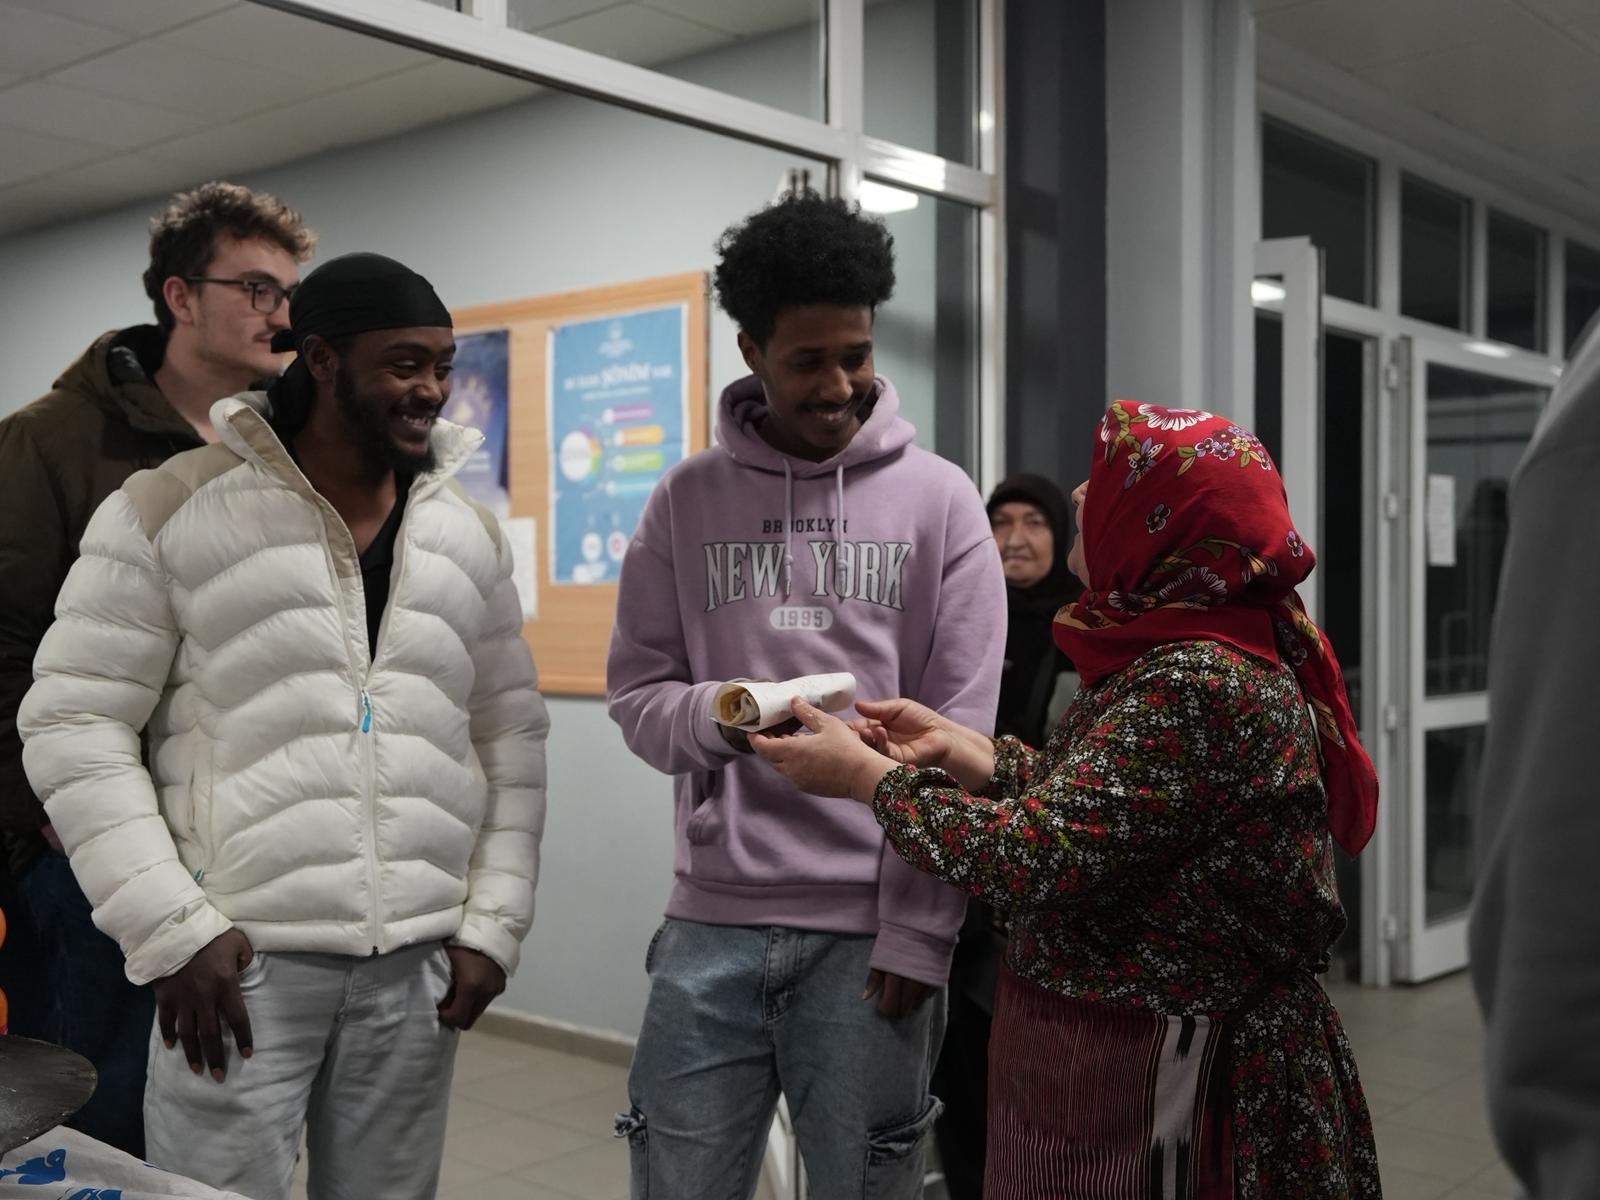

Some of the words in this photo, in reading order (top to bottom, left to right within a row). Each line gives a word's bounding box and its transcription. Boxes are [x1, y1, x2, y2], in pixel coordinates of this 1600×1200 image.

[703, 541, 786, 612] NEW
[808, 540, 912, 611] YORK
[778, 610, 824, 627] 1995
